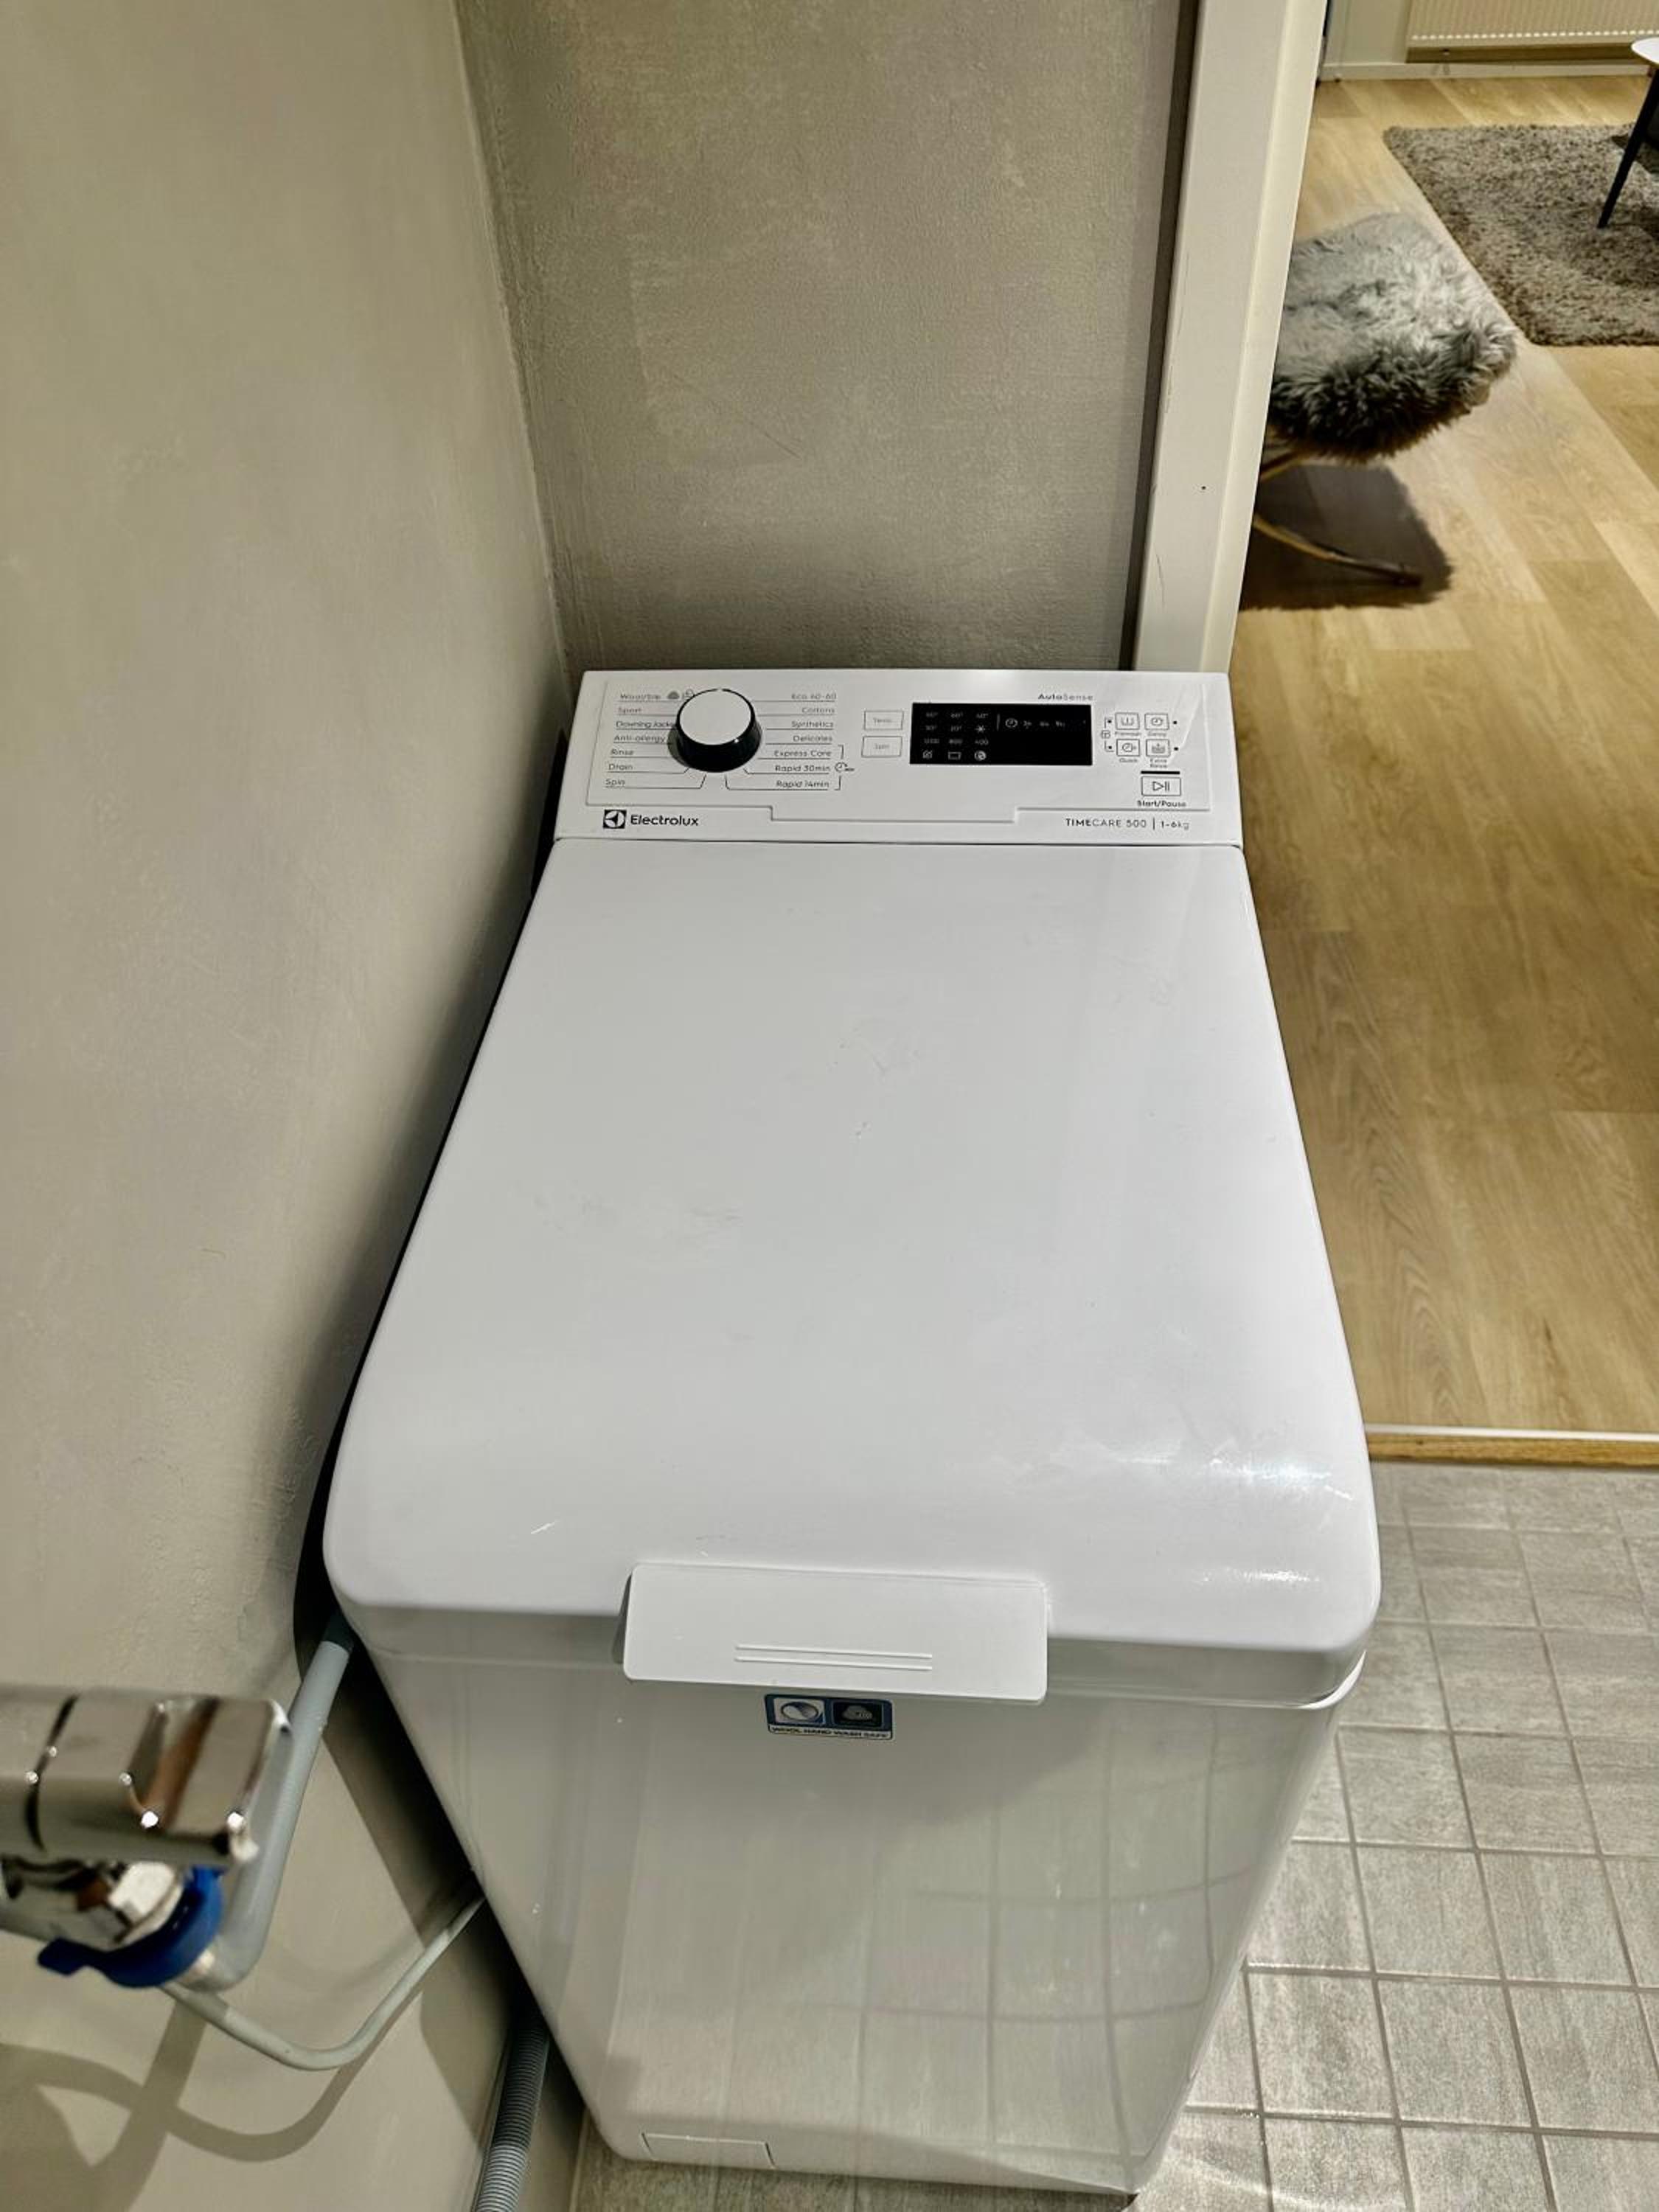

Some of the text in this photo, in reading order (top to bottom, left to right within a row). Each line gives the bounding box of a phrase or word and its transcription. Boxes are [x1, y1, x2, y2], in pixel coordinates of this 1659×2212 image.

[790, 720, 834, 729] Synthetics
[773, 750, 808, 758] Express
[775, 765, 801, 773] Rapid
[605, 778, 626, 787] Spin
[776, 779, 803, 788] Rapid
[1136, 799, 1186, 808] Start/Pause
[630, 814, 699, 827] Electrolux
[1065, 818, 1122, 827] TIMECARE
[1126, 818, 1147, 828] 500
